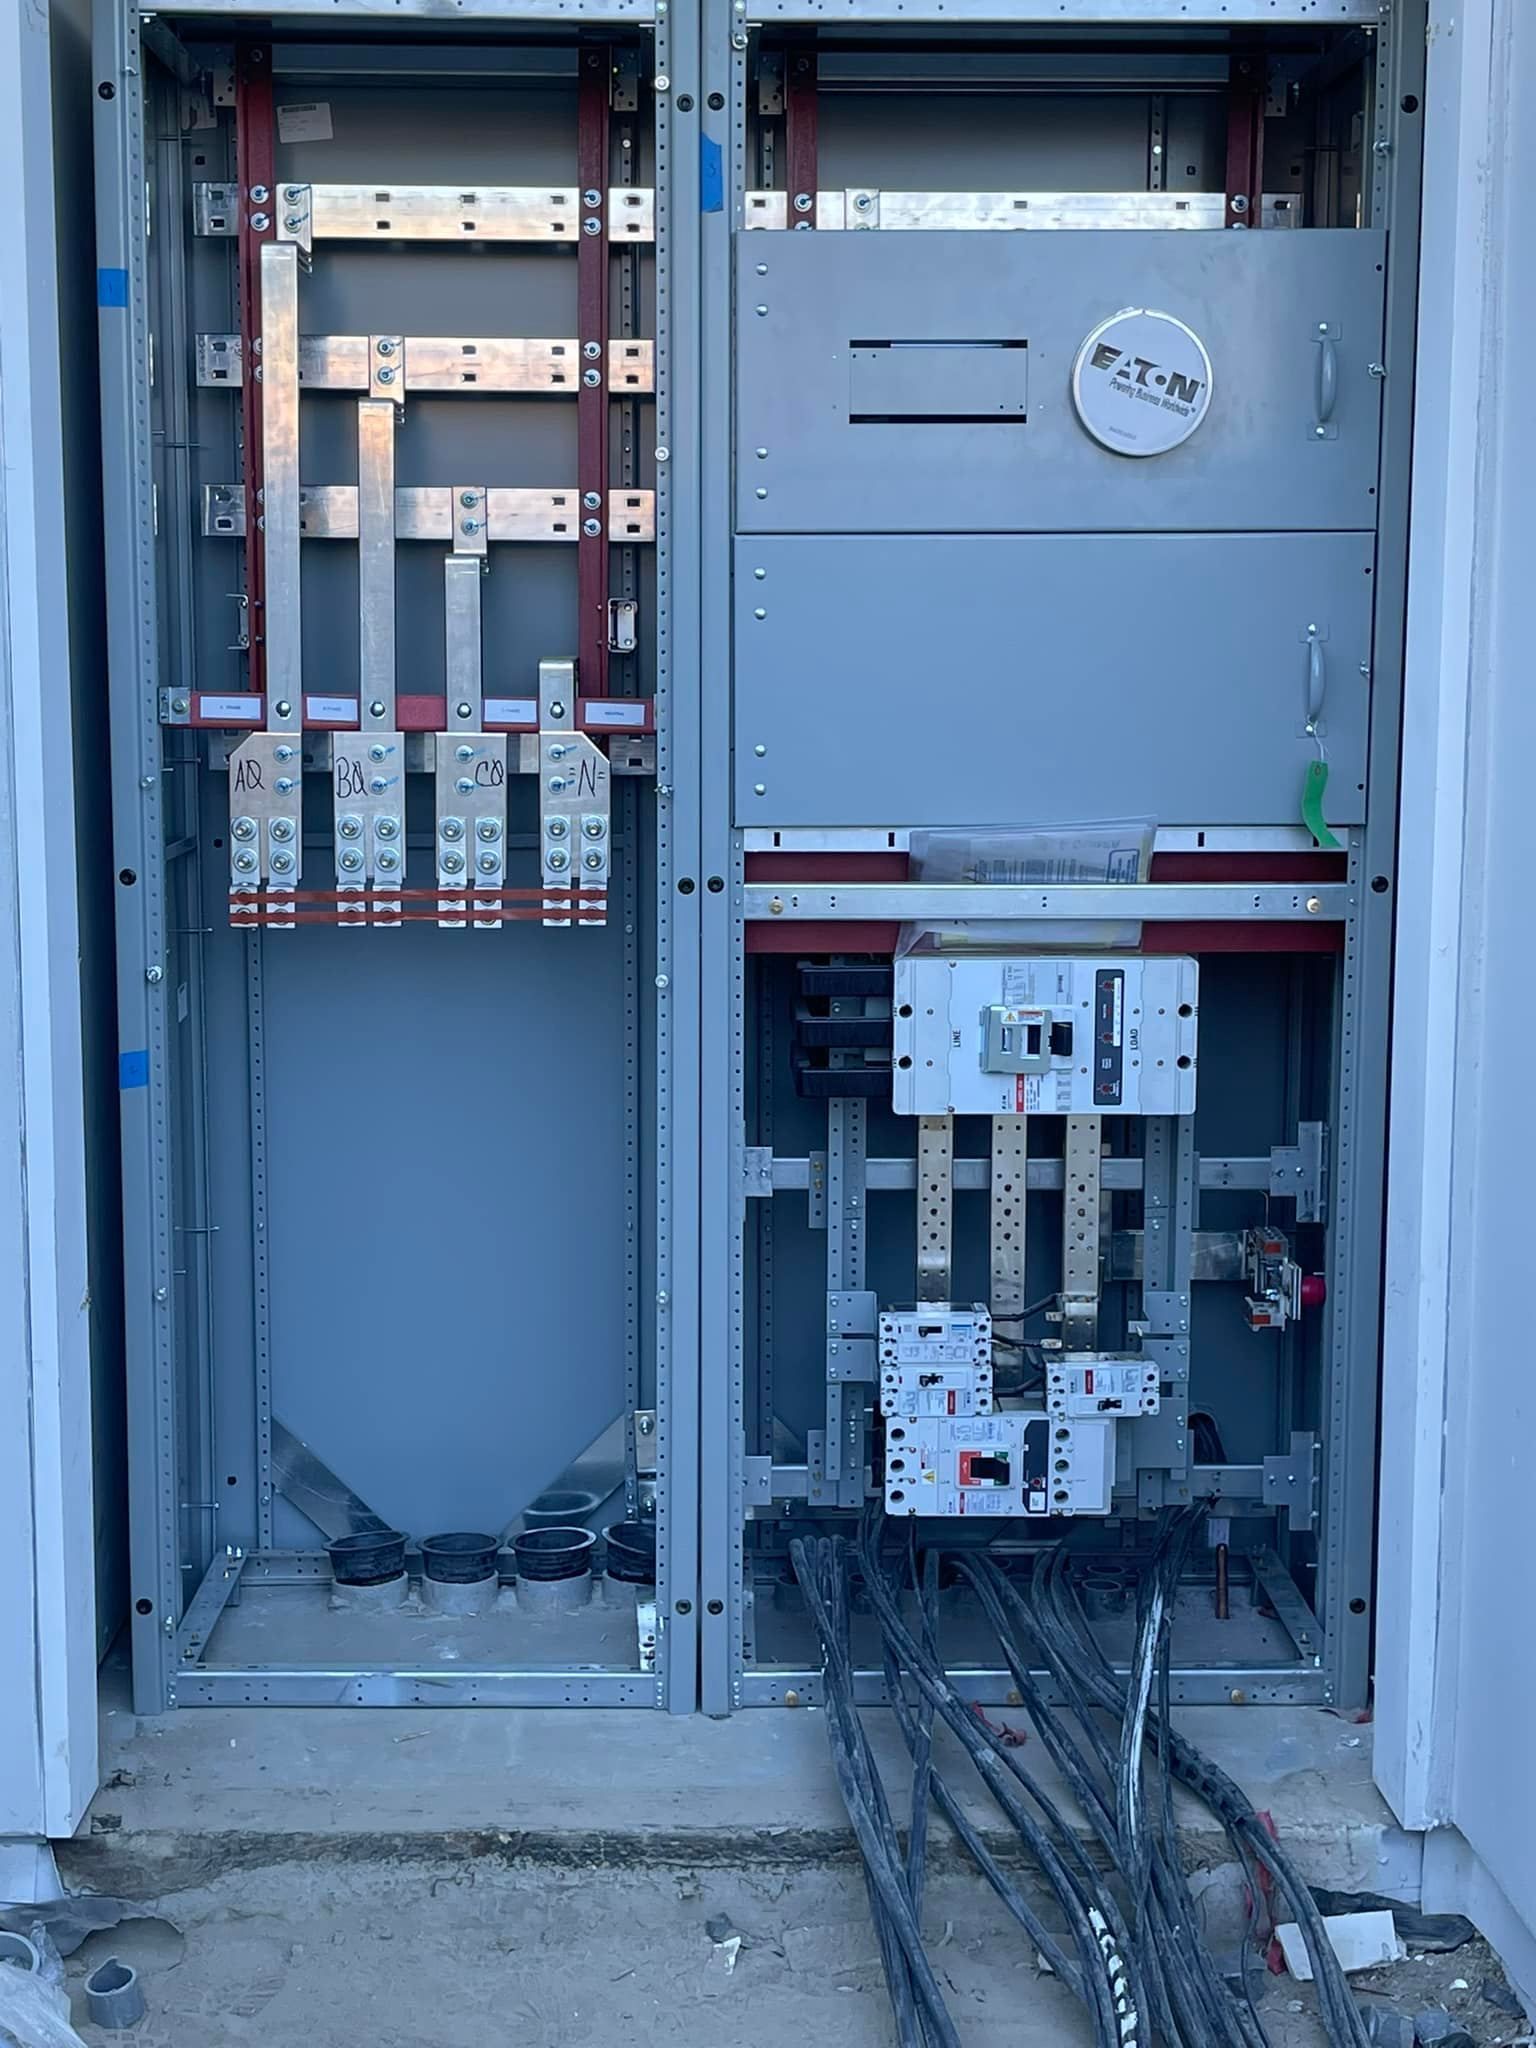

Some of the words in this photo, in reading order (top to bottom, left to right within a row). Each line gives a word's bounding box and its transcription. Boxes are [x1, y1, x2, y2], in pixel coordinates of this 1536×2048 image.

[1090, 342, 1200, 403] EATON
[952, 1029, 961, 1049] LINE
[1129, 1028, 1139, 1051] LOAD
